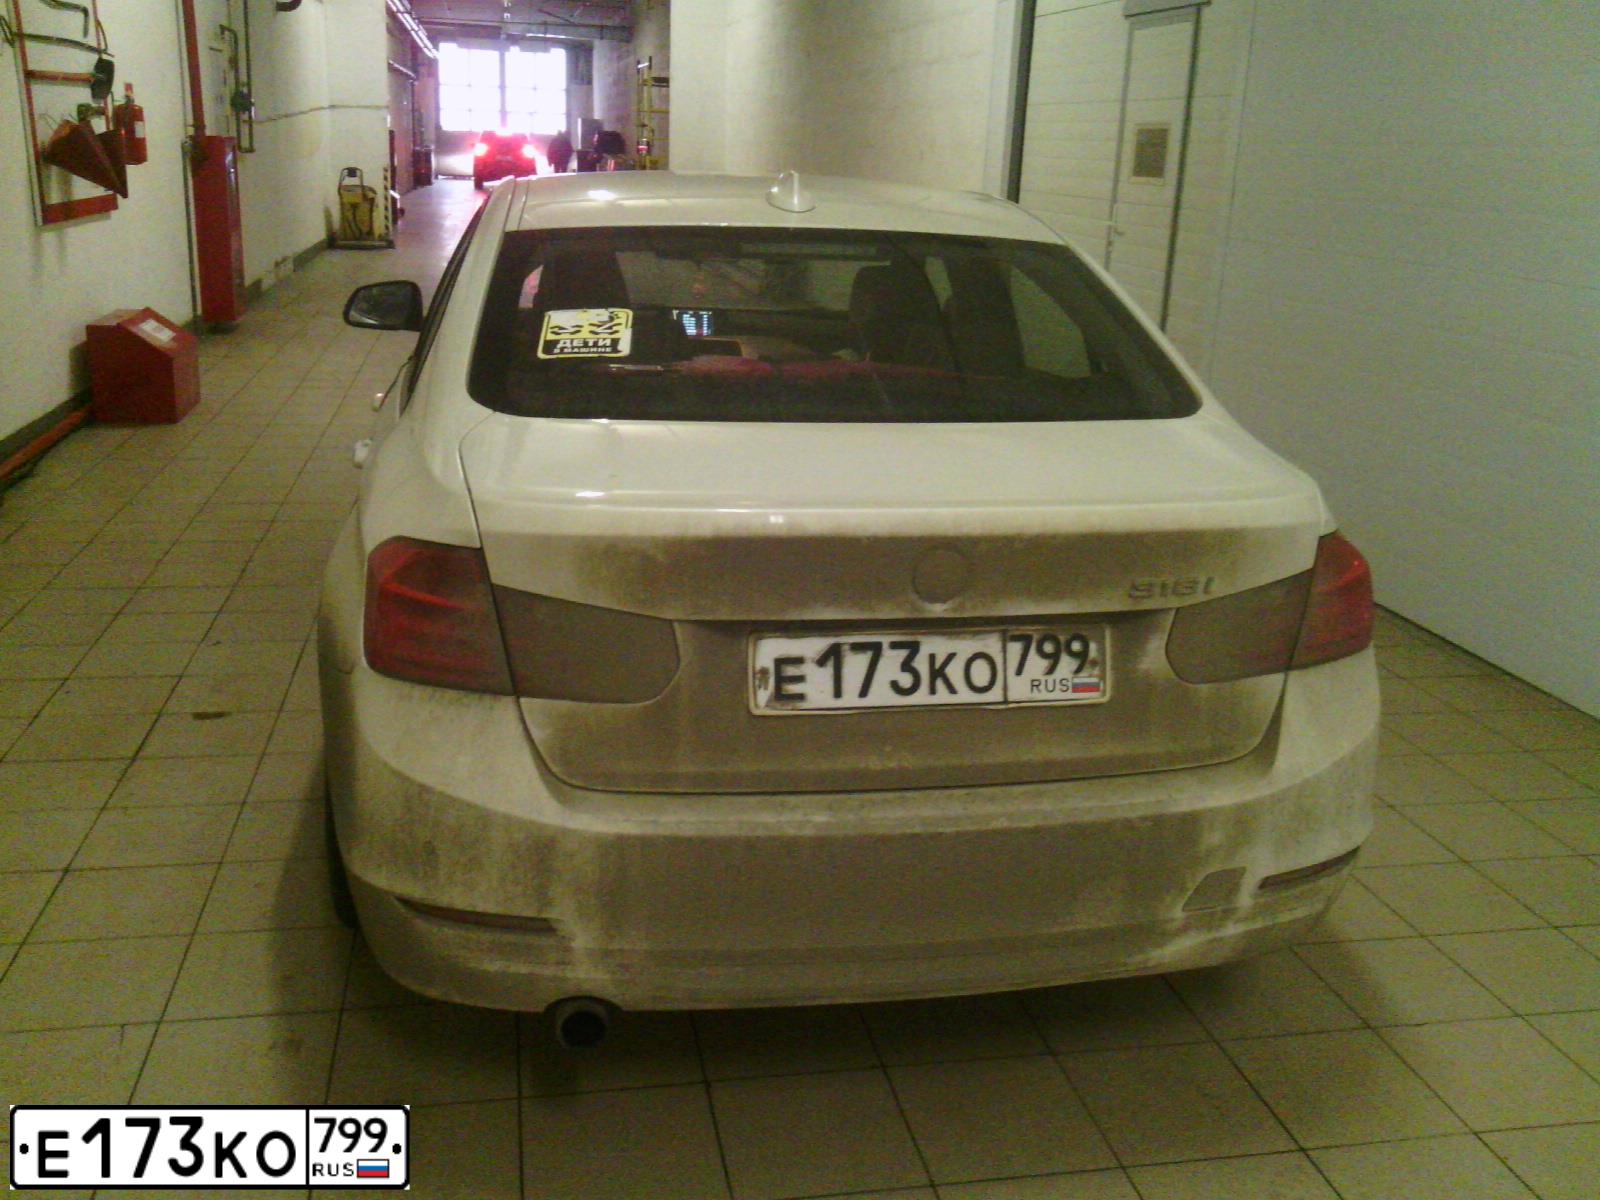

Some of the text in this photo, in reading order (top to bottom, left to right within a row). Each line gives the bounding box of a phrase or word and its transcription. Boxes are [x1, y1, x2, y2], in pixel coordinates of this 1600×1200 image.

[556, 338, 611, 348] ДЕТИ
[1008, 632, 1090, 676] 799
[1030, 677, 1070, 694] RUS
